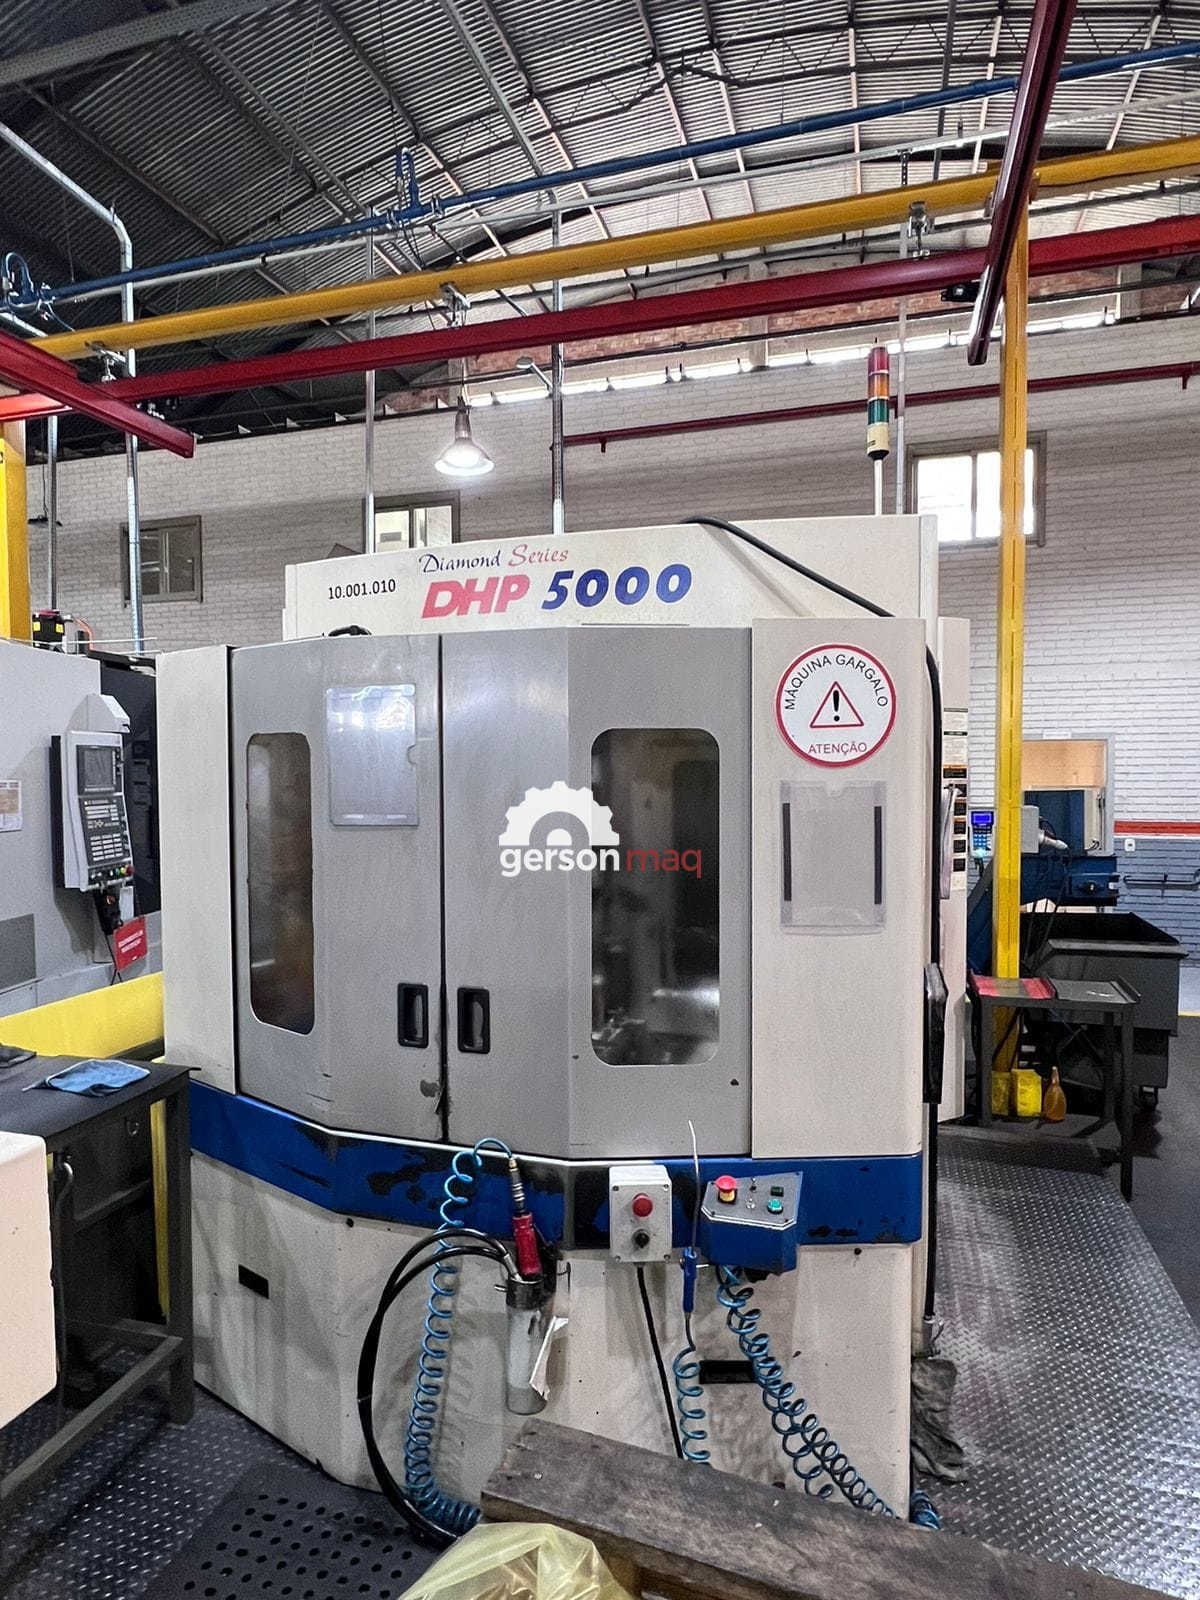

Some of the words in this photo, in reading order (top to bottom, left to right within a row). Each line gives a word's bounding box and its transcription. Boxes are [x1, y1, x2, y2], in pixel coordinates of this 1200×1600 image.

[419, 549, 501, 573] Diamond
[508, 544, 569, 566] Series
[328, 578, 396, 600] 10.001.010
[421, 573, 530, 619] DHP
[541, 563, 692, 610] 5000
[784, 655, 832, 710] MÁQUINA
[835, 654, 889, 707] GARGALO
[808, 740, 867, 755] ATENÇÃO
